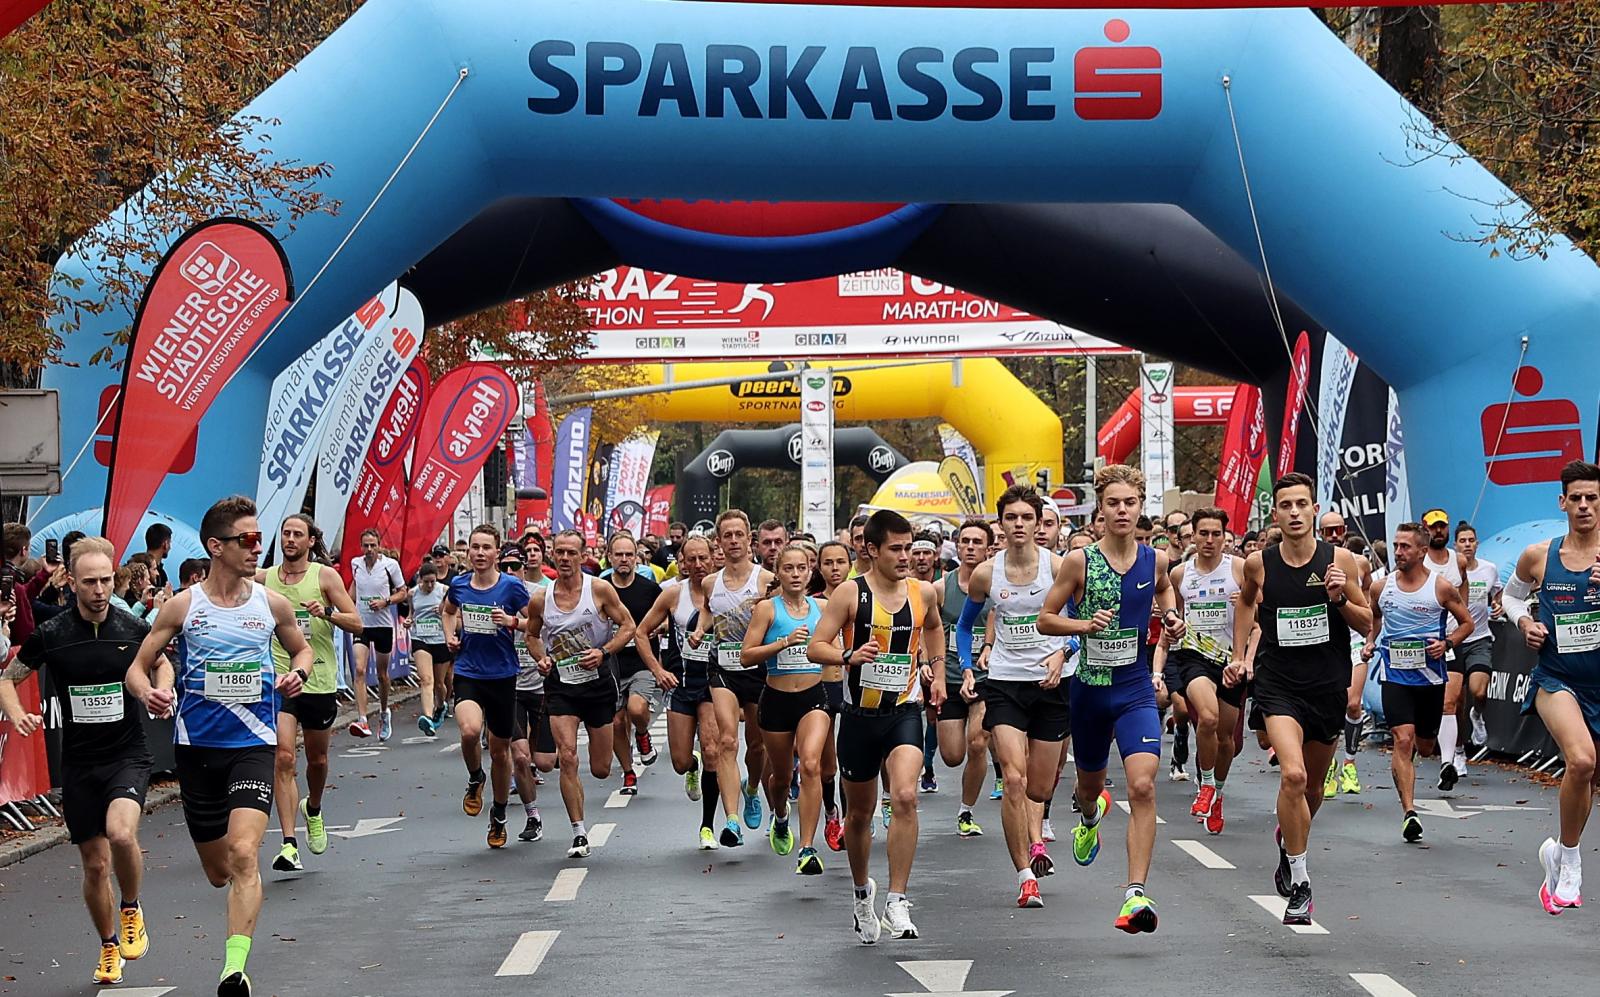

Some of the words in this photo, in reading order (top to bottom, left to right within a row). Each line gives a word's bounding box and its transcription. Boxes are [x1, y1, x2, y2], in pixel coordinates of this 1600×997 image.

[527, 39, 1056, 122] SPARKASSE
[843, 279, 900, 292] ZEITUNG
[882, 300, 1000, 320] MARATHON
[136, 290, 210, 384] WIENER
[156, 268, 264, 400] STÄDTISCHE
[795, 333, 847, 346] GRAZ
[903, 335, 960, 344] HYUNDAI
[636, 337, 686, 349] GRAZ
[182, 374, 212, 412] VIENNA
[208, 318, 254, 374] INSURANCE
[251, 288, 281, 319] GROUP
[267, 318, 365, 490] SPARKASSE
[320, 335, 384, 475] Steiermärkische
[334, 349, 402, 496] SPARKASSE
[710, 455, 732, 472] Buff
[872, 450, 894, 469] Buff
[469, 613, 490, 622] 11592
[1288, 618, 1318, 629] 11832
[1009, 624, 1035, 634] 11501
[1568, 624, 1599, 636] 11862
[786, 647, 807, 656] 1342
[1098, 640, 1128, 650] 13496
[872, 664, 903, 675] 13435
[218, 674, 252, 684] 11860
[82, 696, 112, 706] 13532
